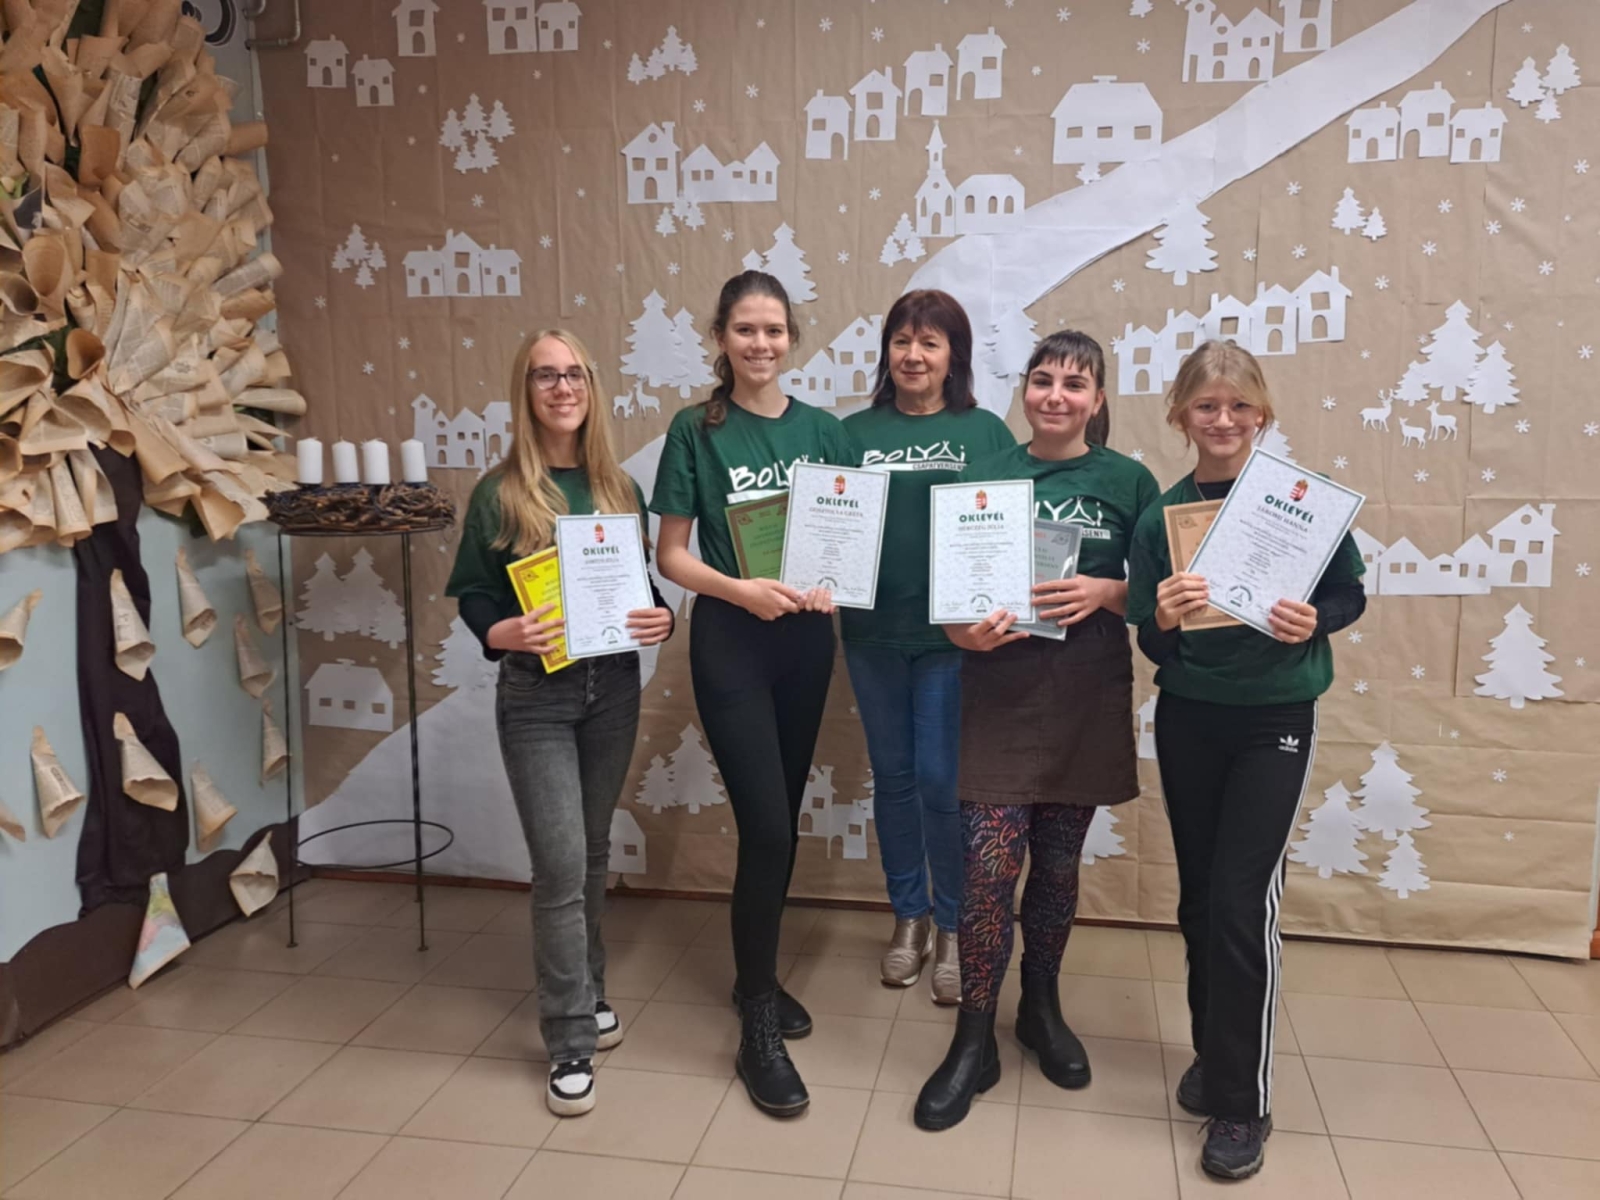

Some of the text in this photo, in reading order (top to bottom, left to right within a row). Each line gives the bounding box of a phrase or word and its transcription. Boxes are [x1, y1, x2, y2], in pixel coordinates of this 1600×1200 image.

[728, 454, 824, 492] BOLY
[959, 511, 1004, 523] OKLEVÉL
[1264, 494, 1314, 524] OKLEVÉL
